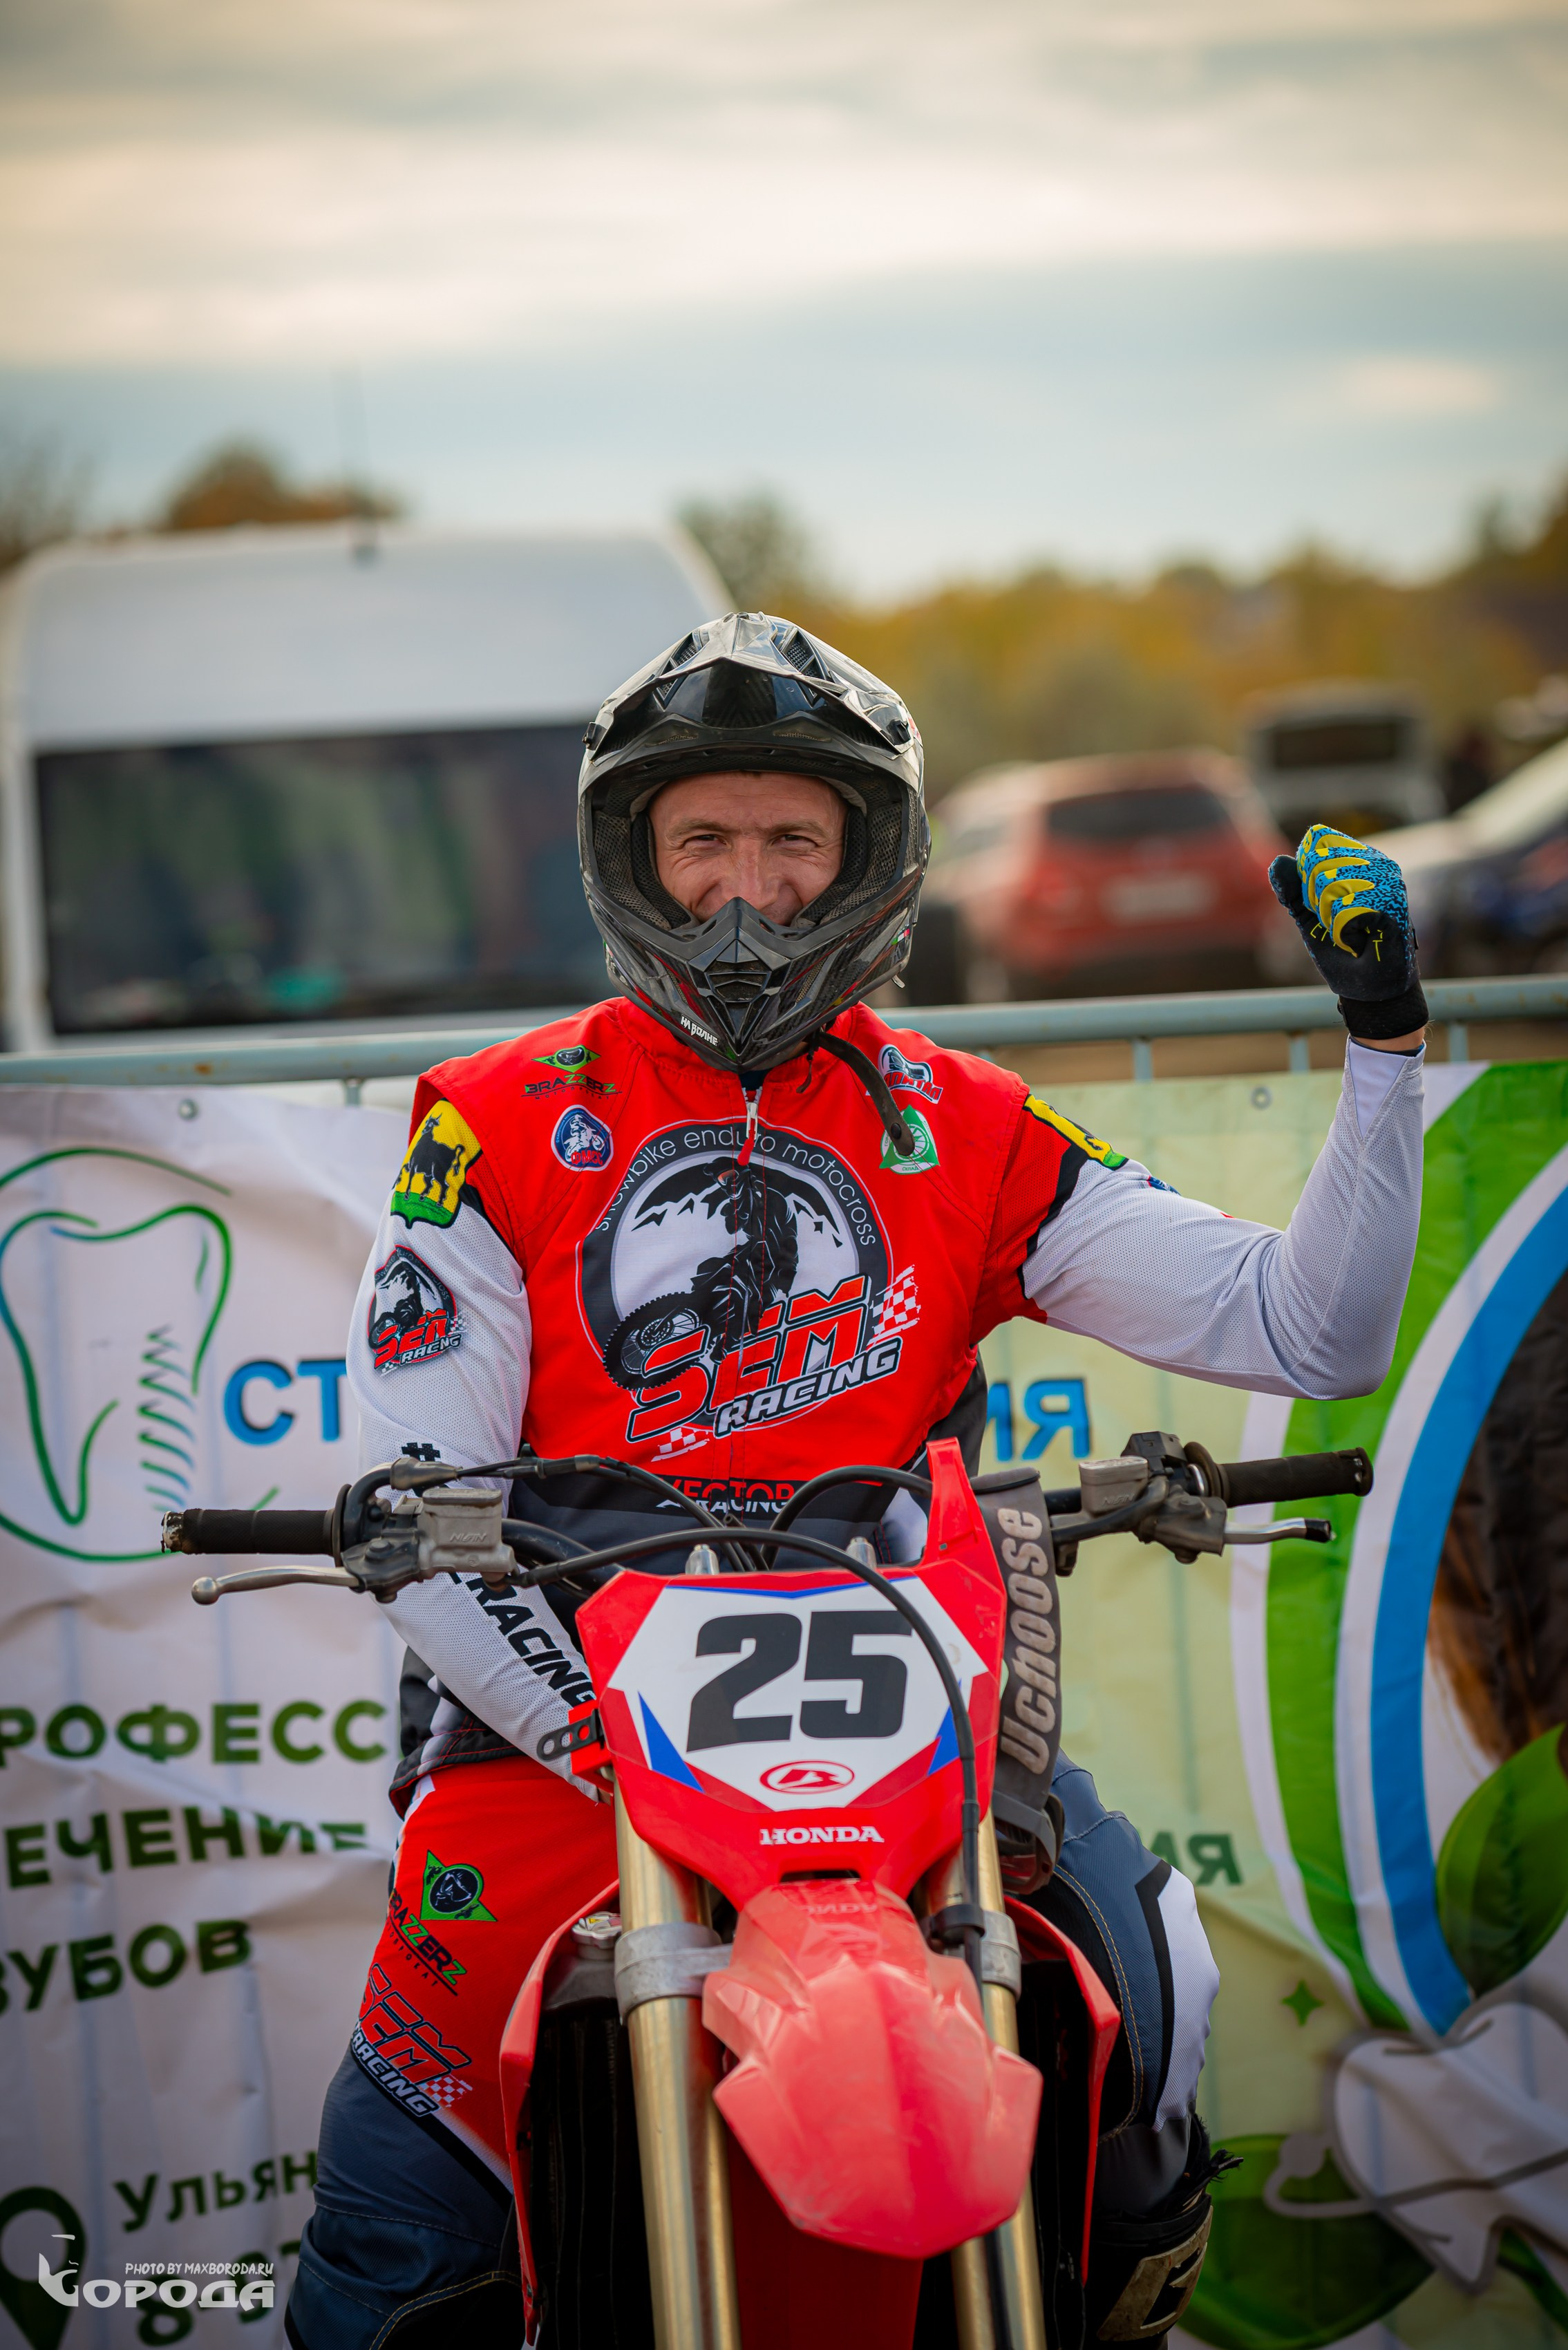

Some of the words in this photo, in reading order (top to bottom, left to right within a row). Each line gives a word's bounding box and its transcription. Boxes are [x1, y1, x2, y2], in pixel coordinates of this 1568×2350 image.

[525, 1073, 617, 1094] BRAZZERZ
[884, 1071, 942, 1100] АПИТАЛ
[683, 1126, 776, 1152] enduro
[782, 1142, 877, 1246] motocross
[374, 1308, 448, 1370] SEM
[627, 1274, 868, 1442] SEM
[715, 1336, 903, 1438] RACING
[686, 1609, 914, 1754] 25
[0, 1700, 402, 1768] РОФЕСС
[759, 1825, 885, 1845] HONDA
[351, 2027, 440, 2117] RACING
